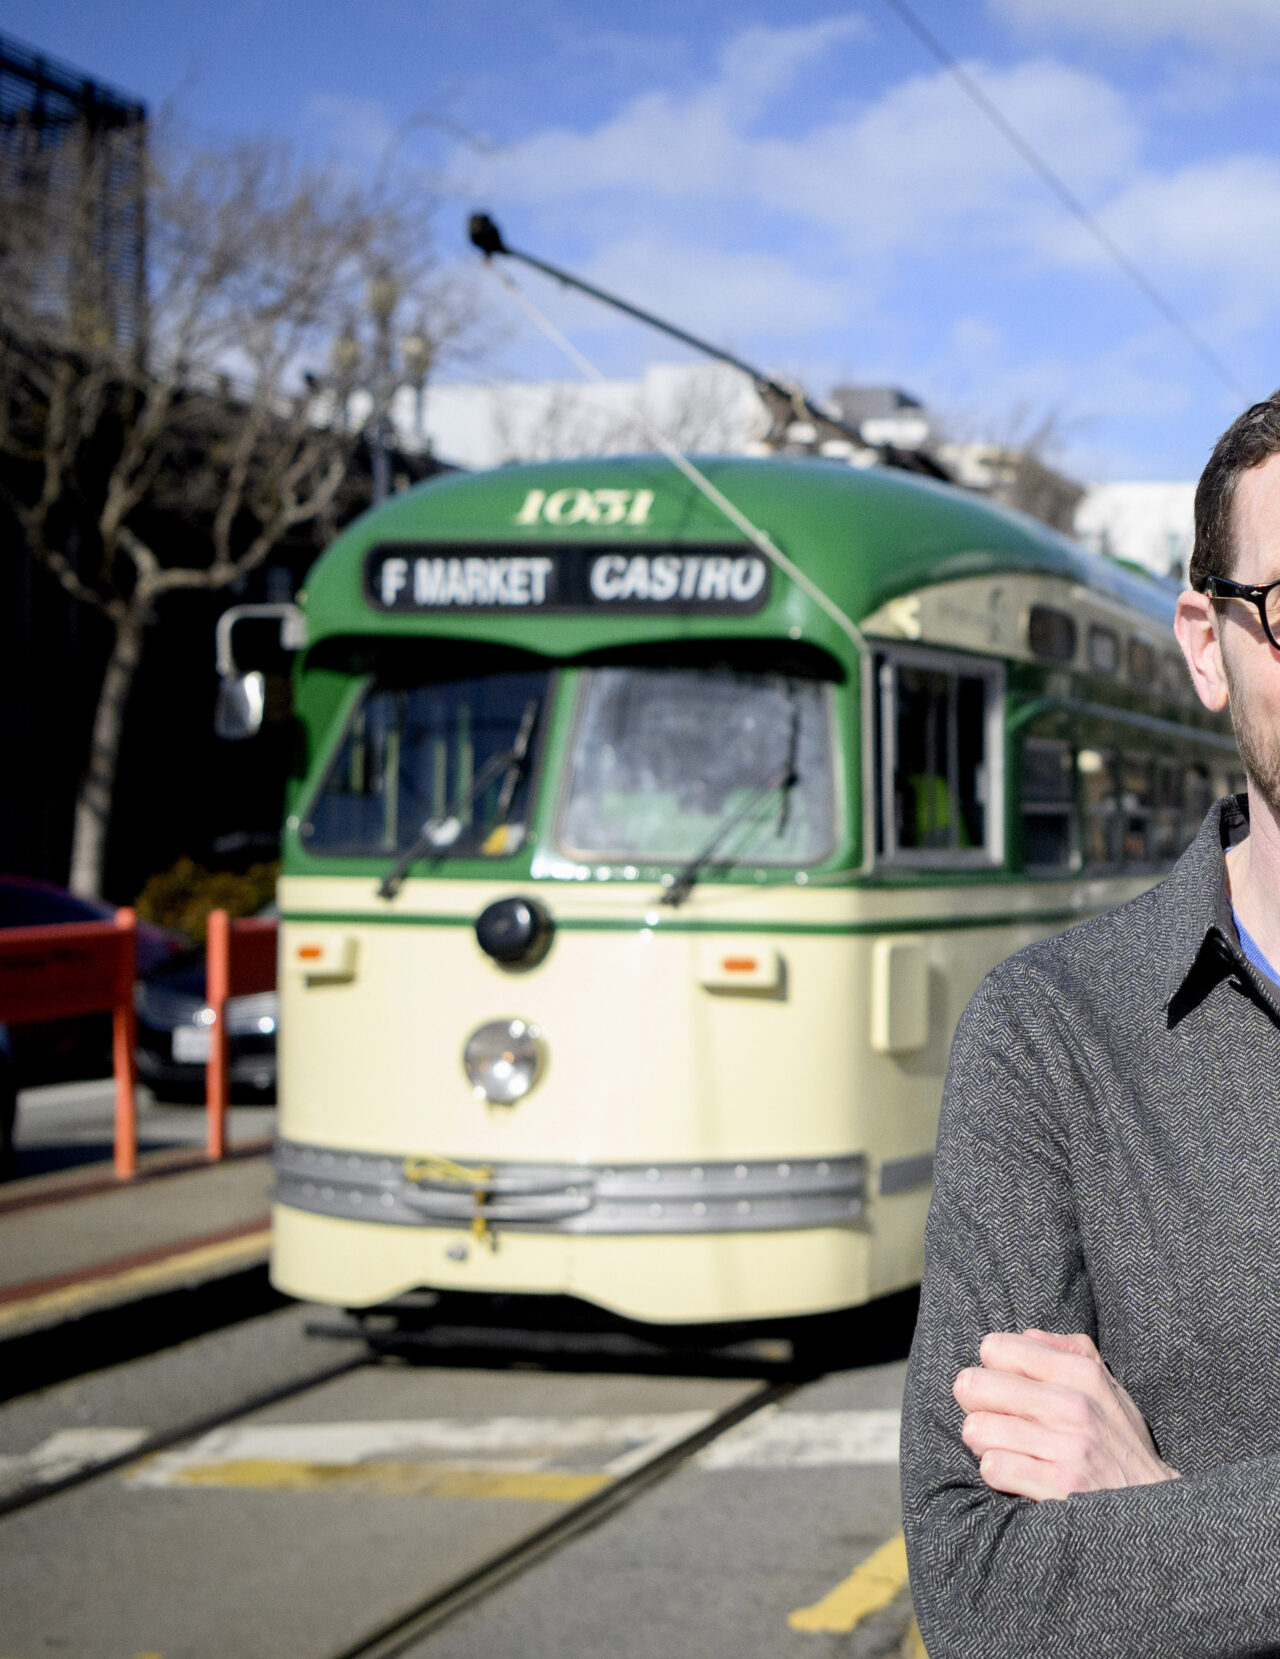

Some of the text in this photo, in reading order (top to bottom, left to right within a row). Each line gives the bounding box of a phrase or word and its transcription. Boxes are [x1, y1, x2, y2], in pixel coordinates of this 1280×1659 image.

[381, 555, 766, 605] F MARKET CASTRO
